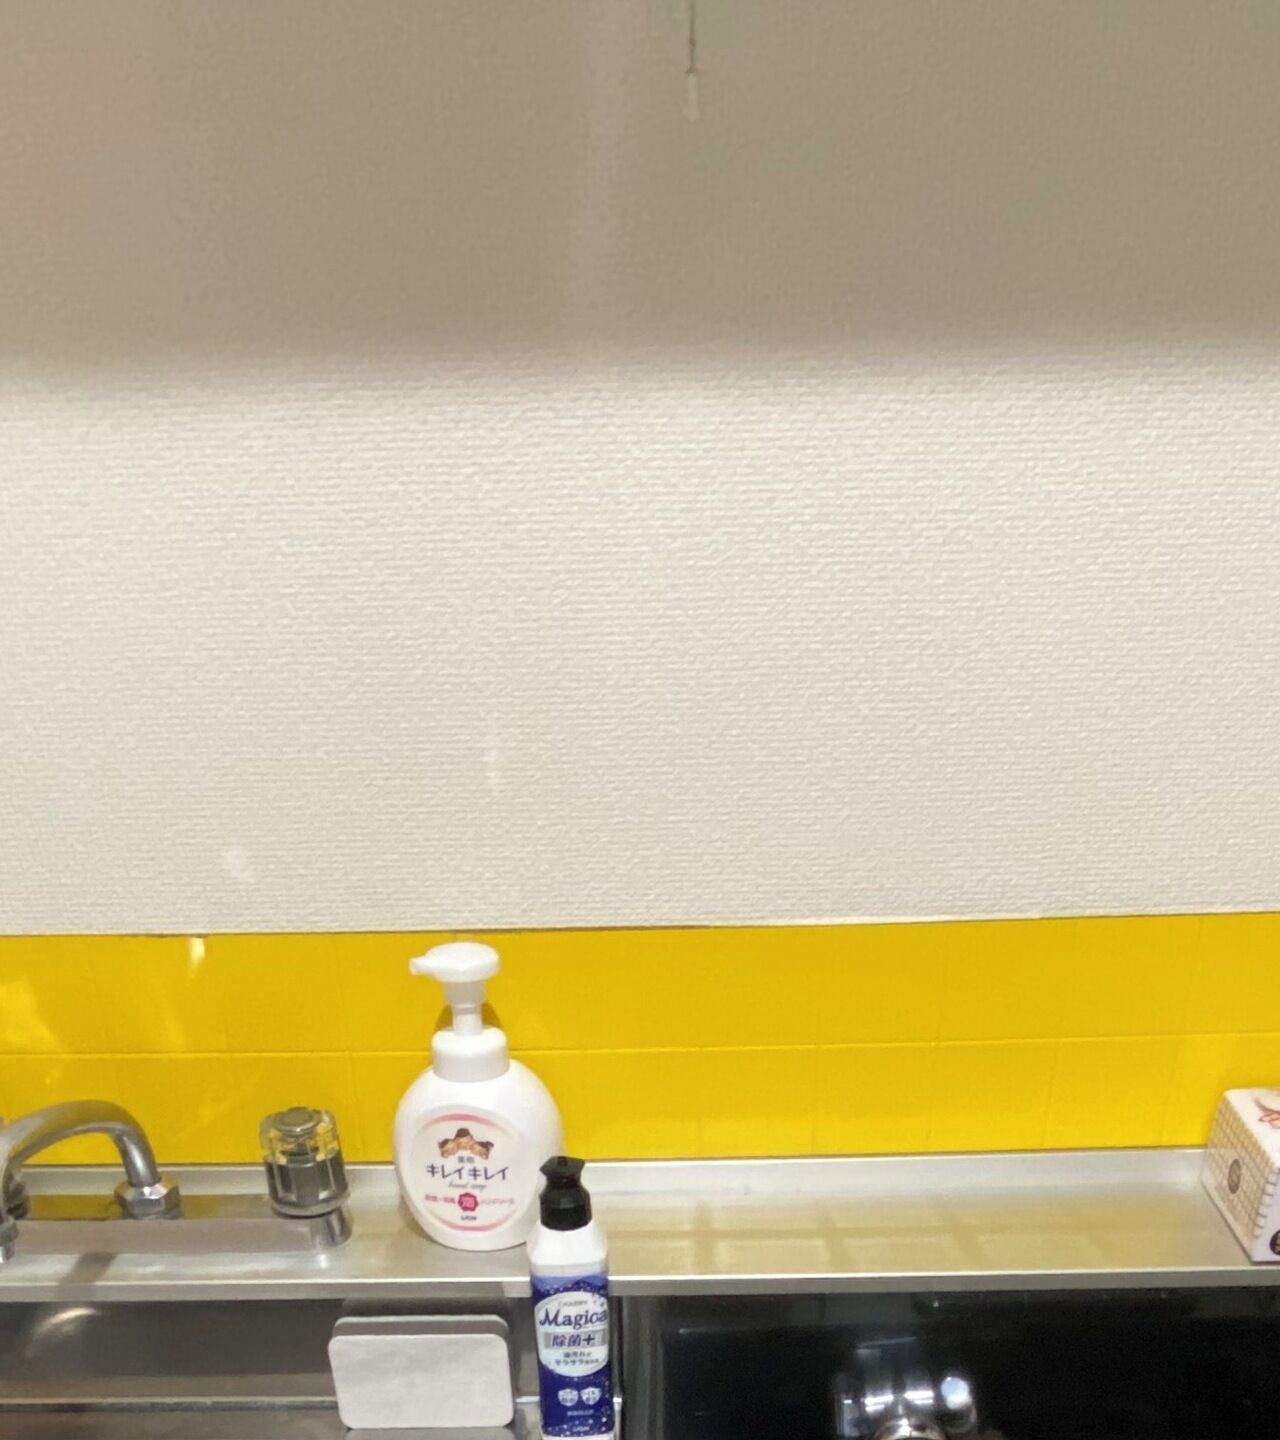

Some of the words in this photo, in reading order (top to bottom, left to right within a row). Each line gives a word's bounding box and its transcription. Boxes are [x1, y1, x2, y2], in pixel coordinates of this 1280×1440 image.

[426, 1163, 509, 1181] キレイキレイ
[539, 1308, 609, 1331] Magica
